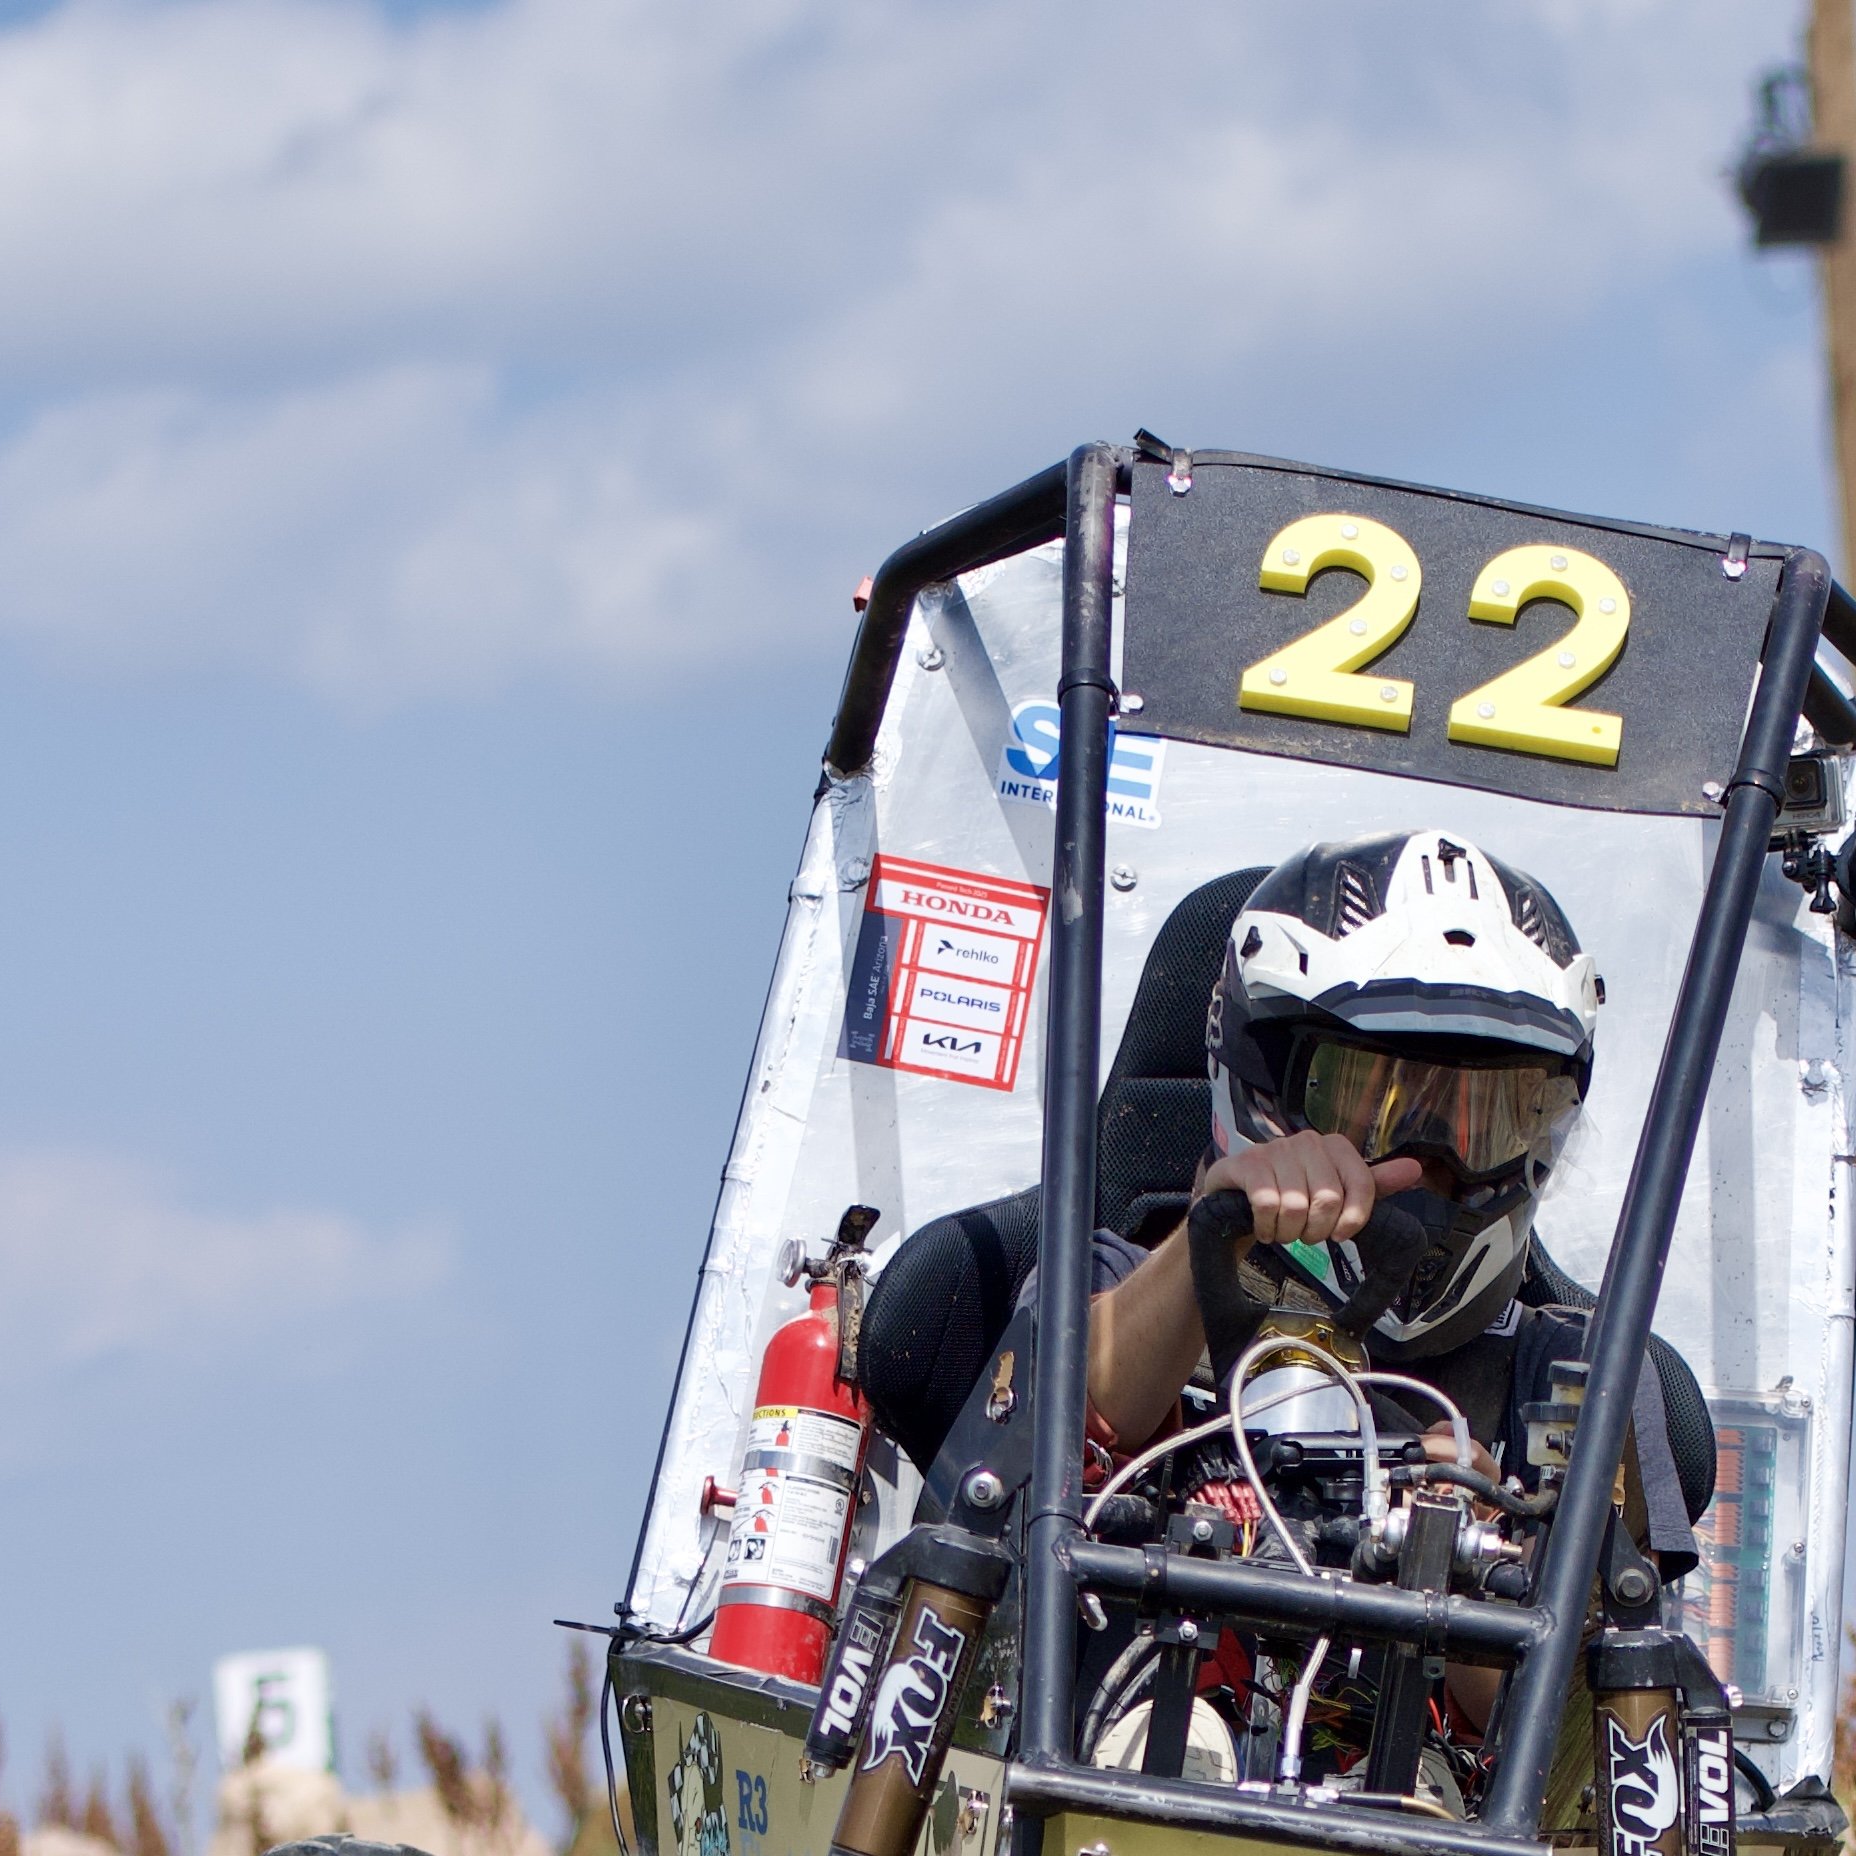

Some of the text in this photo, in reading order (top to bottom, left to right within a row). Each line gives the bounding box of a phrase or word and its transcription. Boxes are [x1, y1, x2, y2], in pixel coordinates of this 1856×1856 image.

[1238, 512, 1632, 769] 22
[1006, 706, 1162, 801] SE
[900, 889, 1016, 926] HONDA
[863, 993, 877, 1020] Baja
[872, 935, 889, 974] Arizona
[956, 947, 999, 964] rehlko
[920, 987, 1001, 1013] POLARIS
[819, 1609, 884, 1736] EVOL
[861, 1605, 966, 1787] FOX
[735, 1768, 769, 1835] R3
